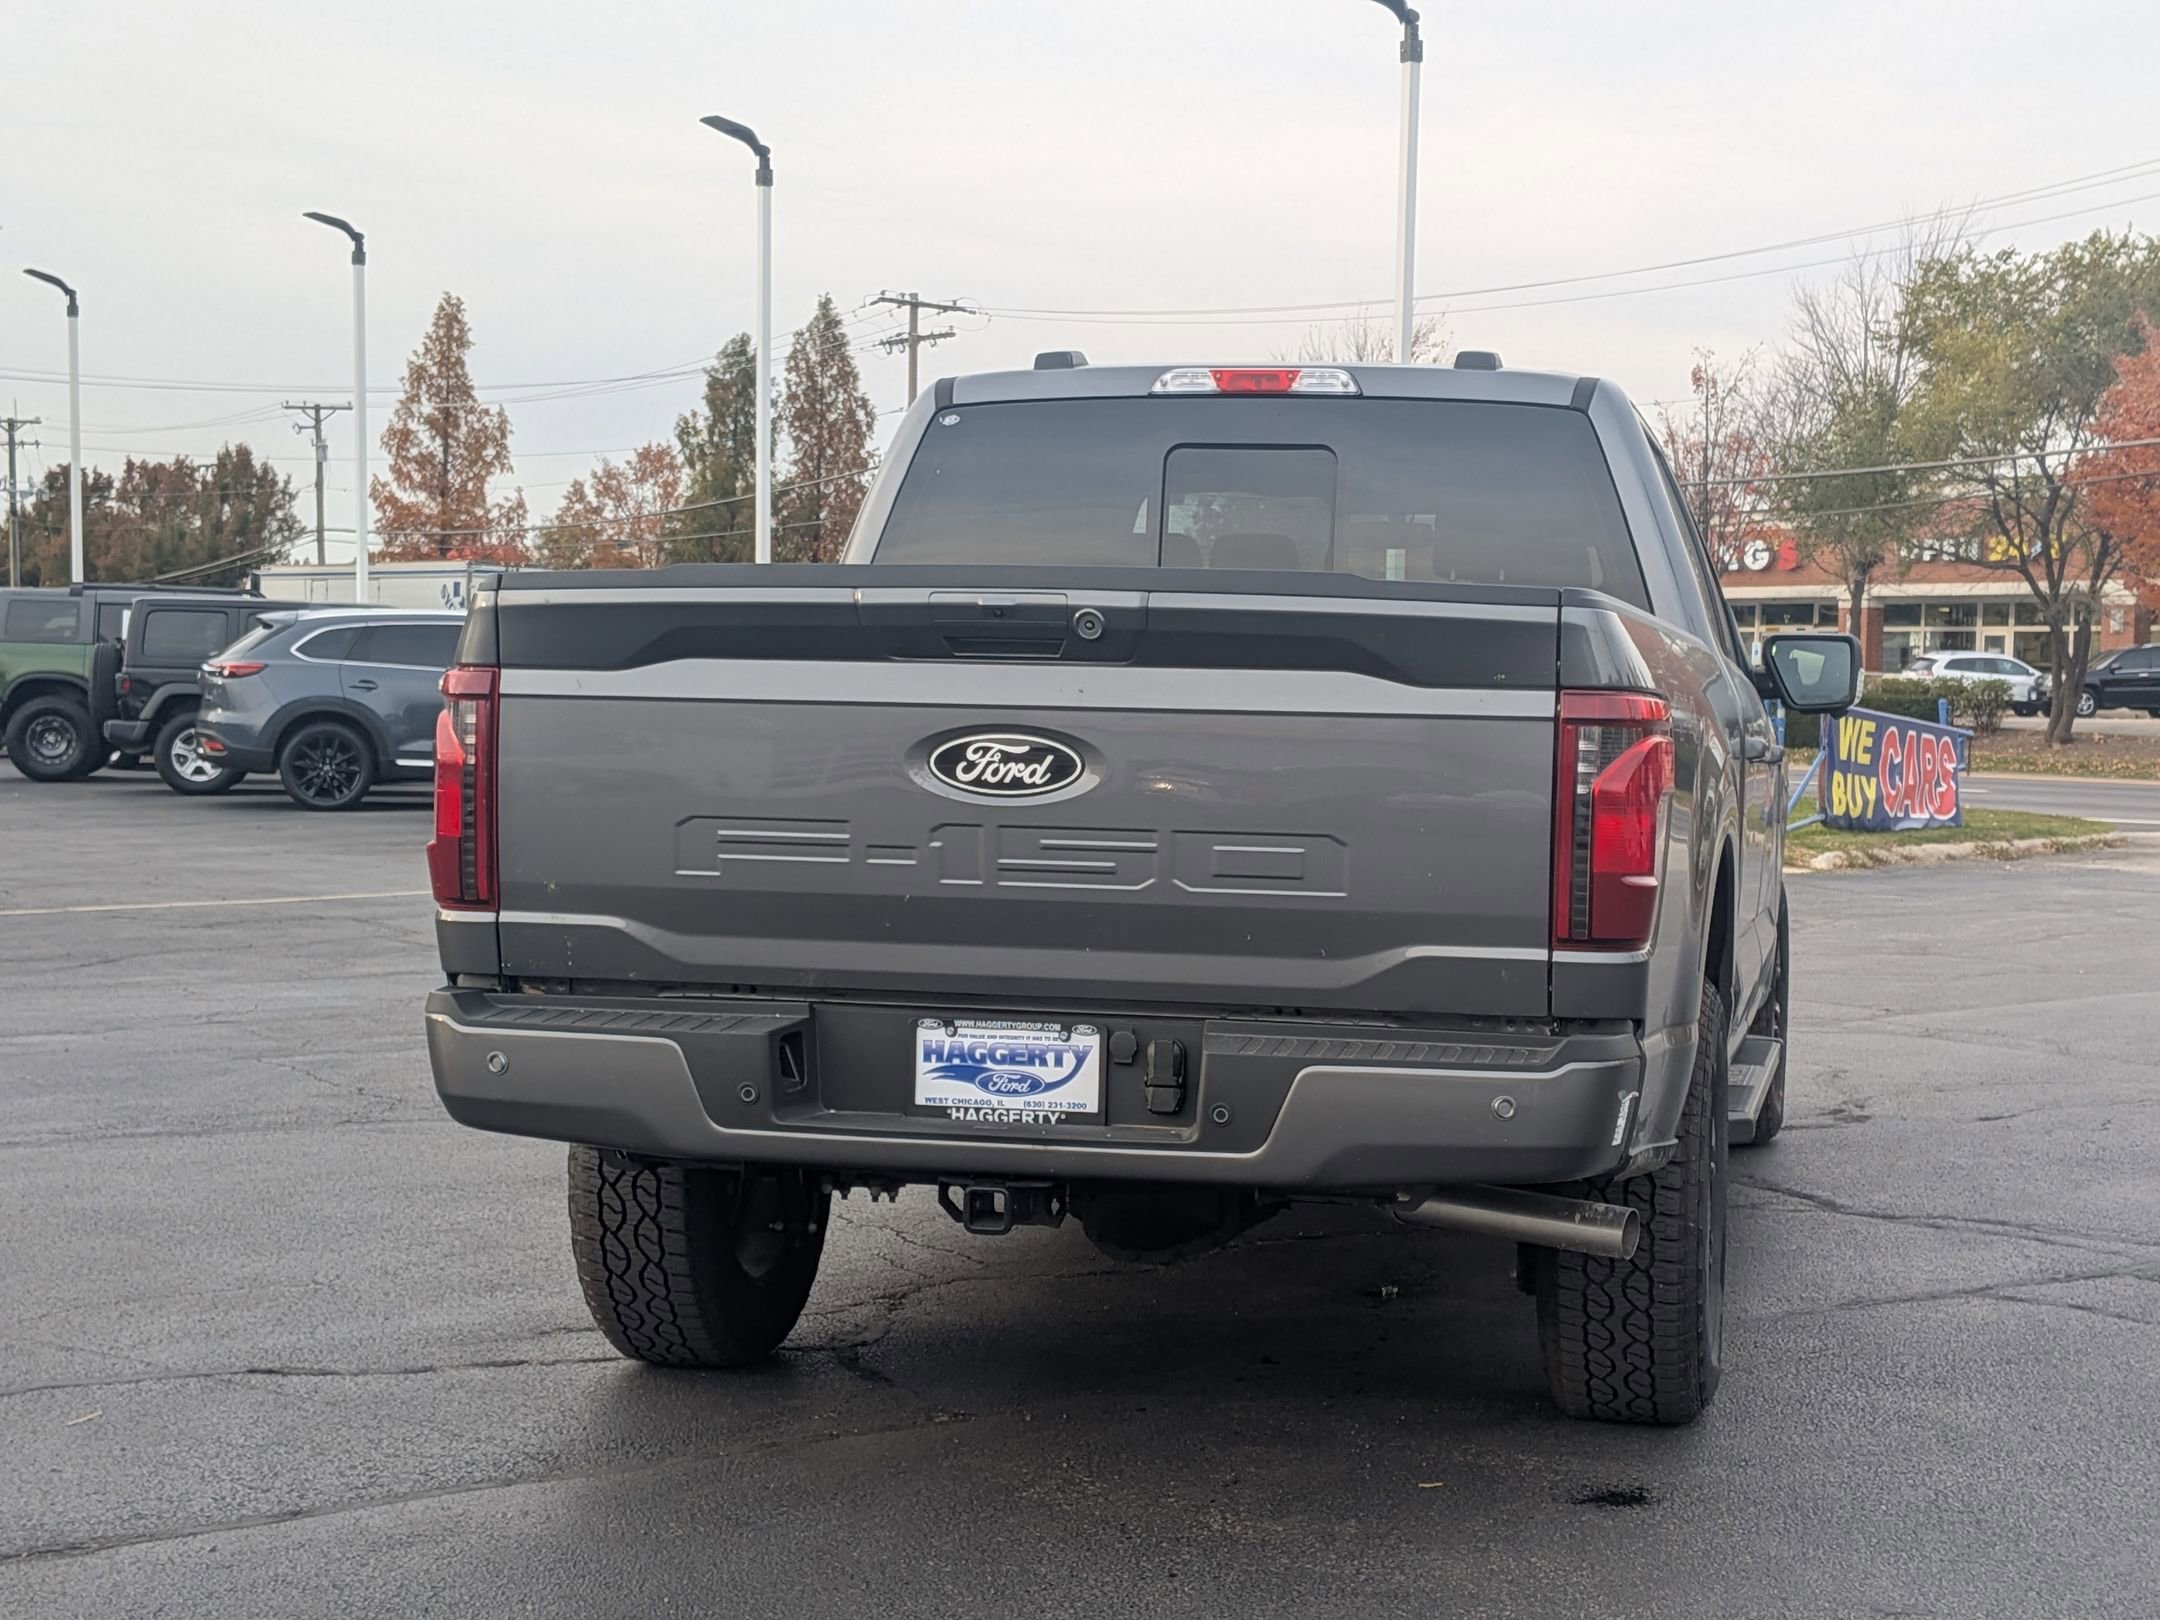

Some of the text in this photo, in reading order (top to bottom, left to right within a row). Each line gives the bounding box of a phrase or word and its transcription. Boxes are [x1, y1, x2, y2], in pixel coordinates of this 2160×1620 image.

[1839, 716, 1876, 765] WE
[955, 741, 1054, 786] Ford
[1879, 726, 1957, 820] CARS
[1832, 770, 1877, 819] BUY
[675, 815, 1349, 897] F-150
[954, 1019, 1061, 1031] WWW.HAGGERTYGROUP.COM
[922, 1040, 1093, 1070] HAGGERTY
[988, 1074, 1031, 1092] Ford
[924, 1097, 948, 1105] WEST
[952, 1098, 995, 1108] CHICAGO,
[1023, 1101, 1045, 1109] (630)
[1048, 1102, 1087, 1110] 231-3200
[951, 1108, 1060, 1125] HAGGERTY
